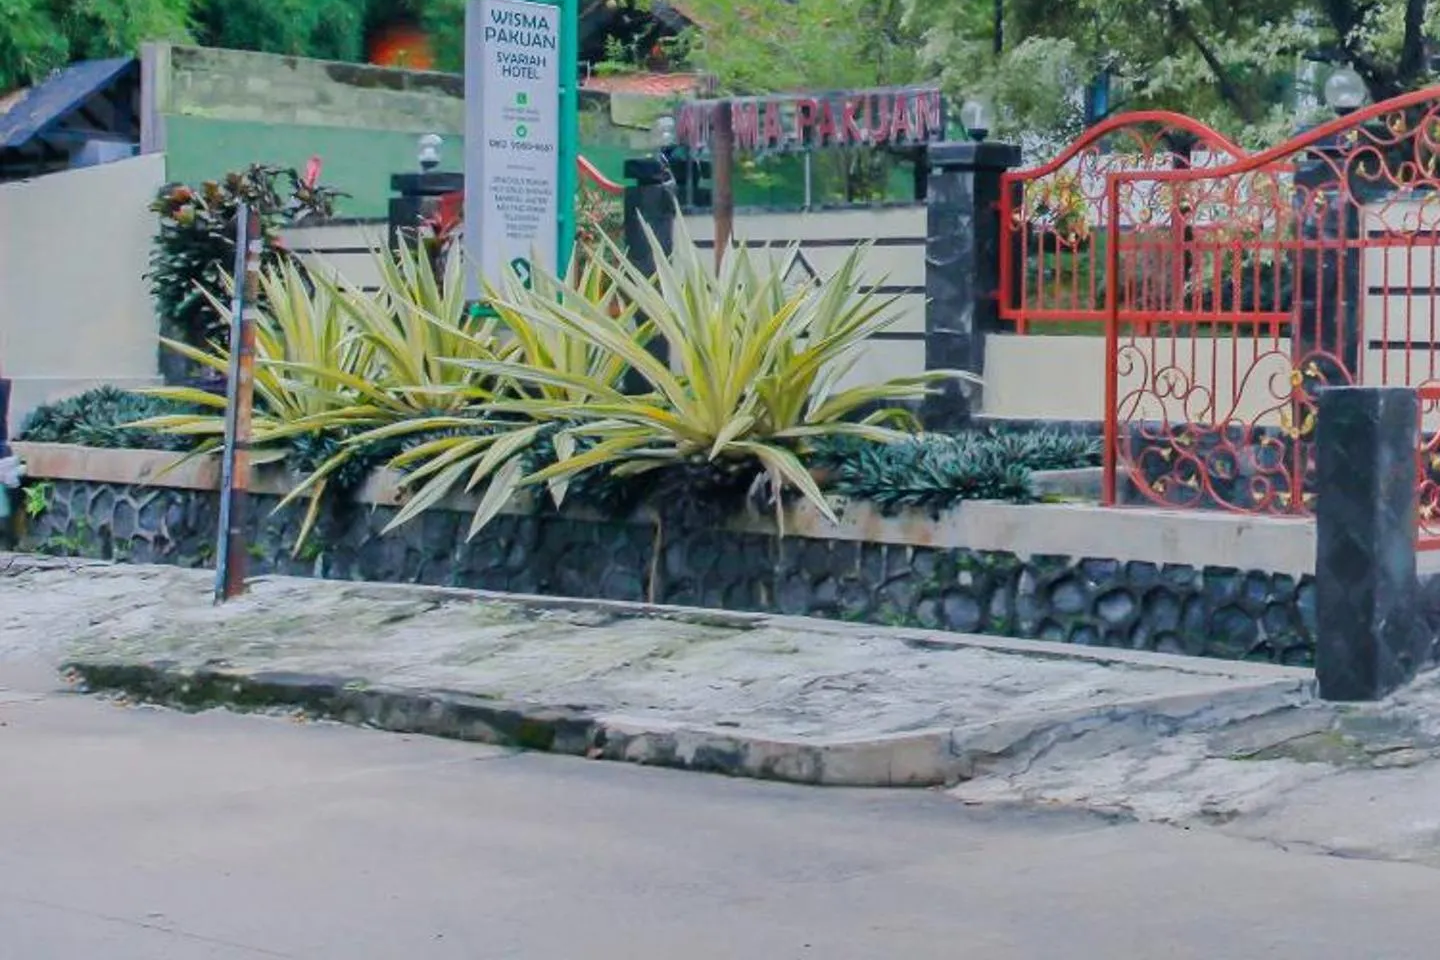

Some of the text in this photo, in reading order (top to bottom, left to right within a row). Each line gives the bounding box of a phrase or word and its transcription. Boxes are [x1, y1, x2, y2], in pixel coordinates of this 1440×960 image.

[490, 9, 550, 31] WISMA
[485, 26, 556, 49] PAKUAN
[496, 51, 547, 68] SYARIAH
[502, 65, 541, 80] HOTEL
[676, 89, 941, 148] WIMA PAKUAN
